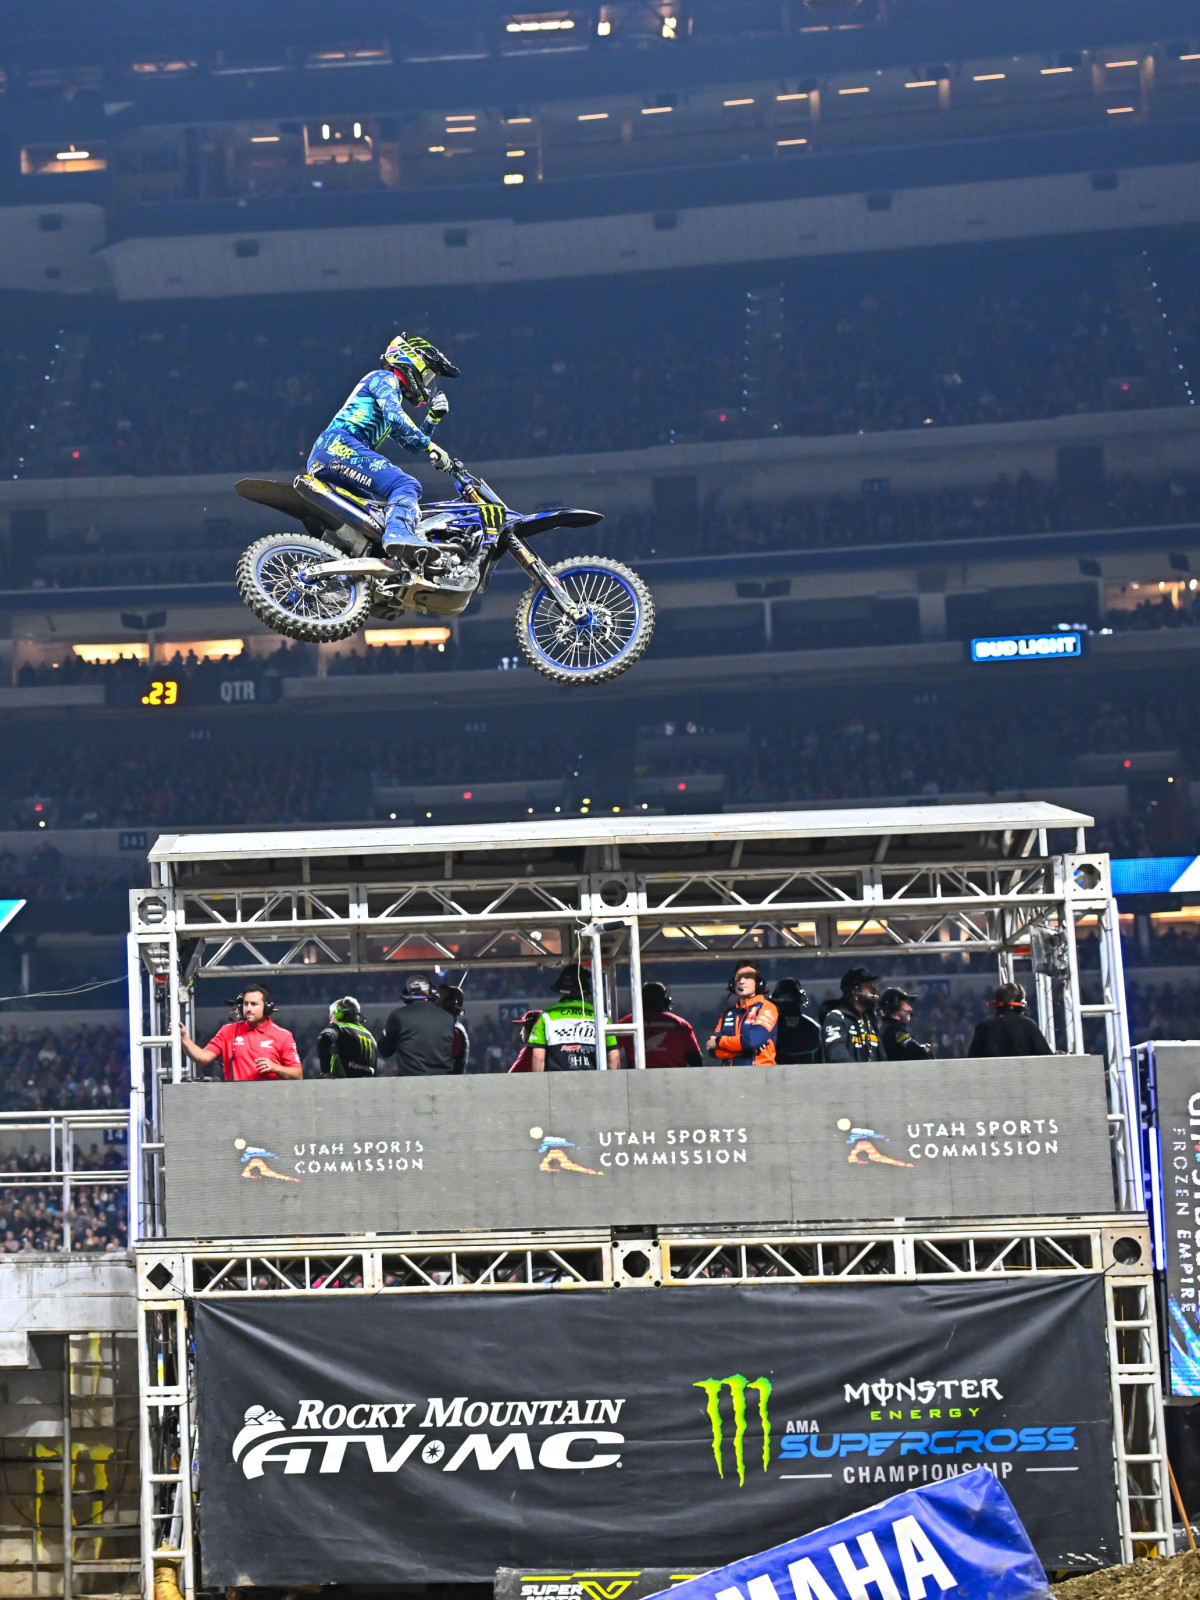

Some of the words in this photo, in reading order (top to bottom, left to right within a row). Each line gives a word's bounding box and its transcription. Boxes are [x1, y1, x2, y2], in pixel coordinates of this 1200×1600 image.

[339, 465, 373, 487] YAMAHA
[975, 640, 1018, 658] BUD
[1018, 636, 1077, 656] LIGHT
[220, 681, 256, 703] QTR
[598, 1131, 656, 1146] UTAH
[667, 1128, 748, 1144] SPORTS
[907, 1122, 966, 1138] UTAH
[976, 1119, 1060, 1136] SPORTS
[294, 1143, 345, 1156] UTAH
[352, 1140, 424, 1155] SPORTS
[600, 1149, 748, 1167] COMMISSION
[908, 1140, 1060, 1159] COMMISSION
[294, 1158, 424, 1175] COMMISSION
[1173, 1128, 1190, 1216] FROZEN
[1177, 1229, 1197, 1314] EMPIRE
[843, 1377, 1004, 1407] MONSTER
[292, 1399, 416, 1430] ROCKY
[420, 1397, 626, 1429] MOUNTAIN
[870, 1407, 981, 1421] ENERGY
[785, 1420, 820, 1434] AMA
[777, 1426, 1077, 1460] SUPERCROSS
[843, 1462, 1014, 1484] CHAMPIONSIP
[520, 1584, 584, 1596] SUPER
